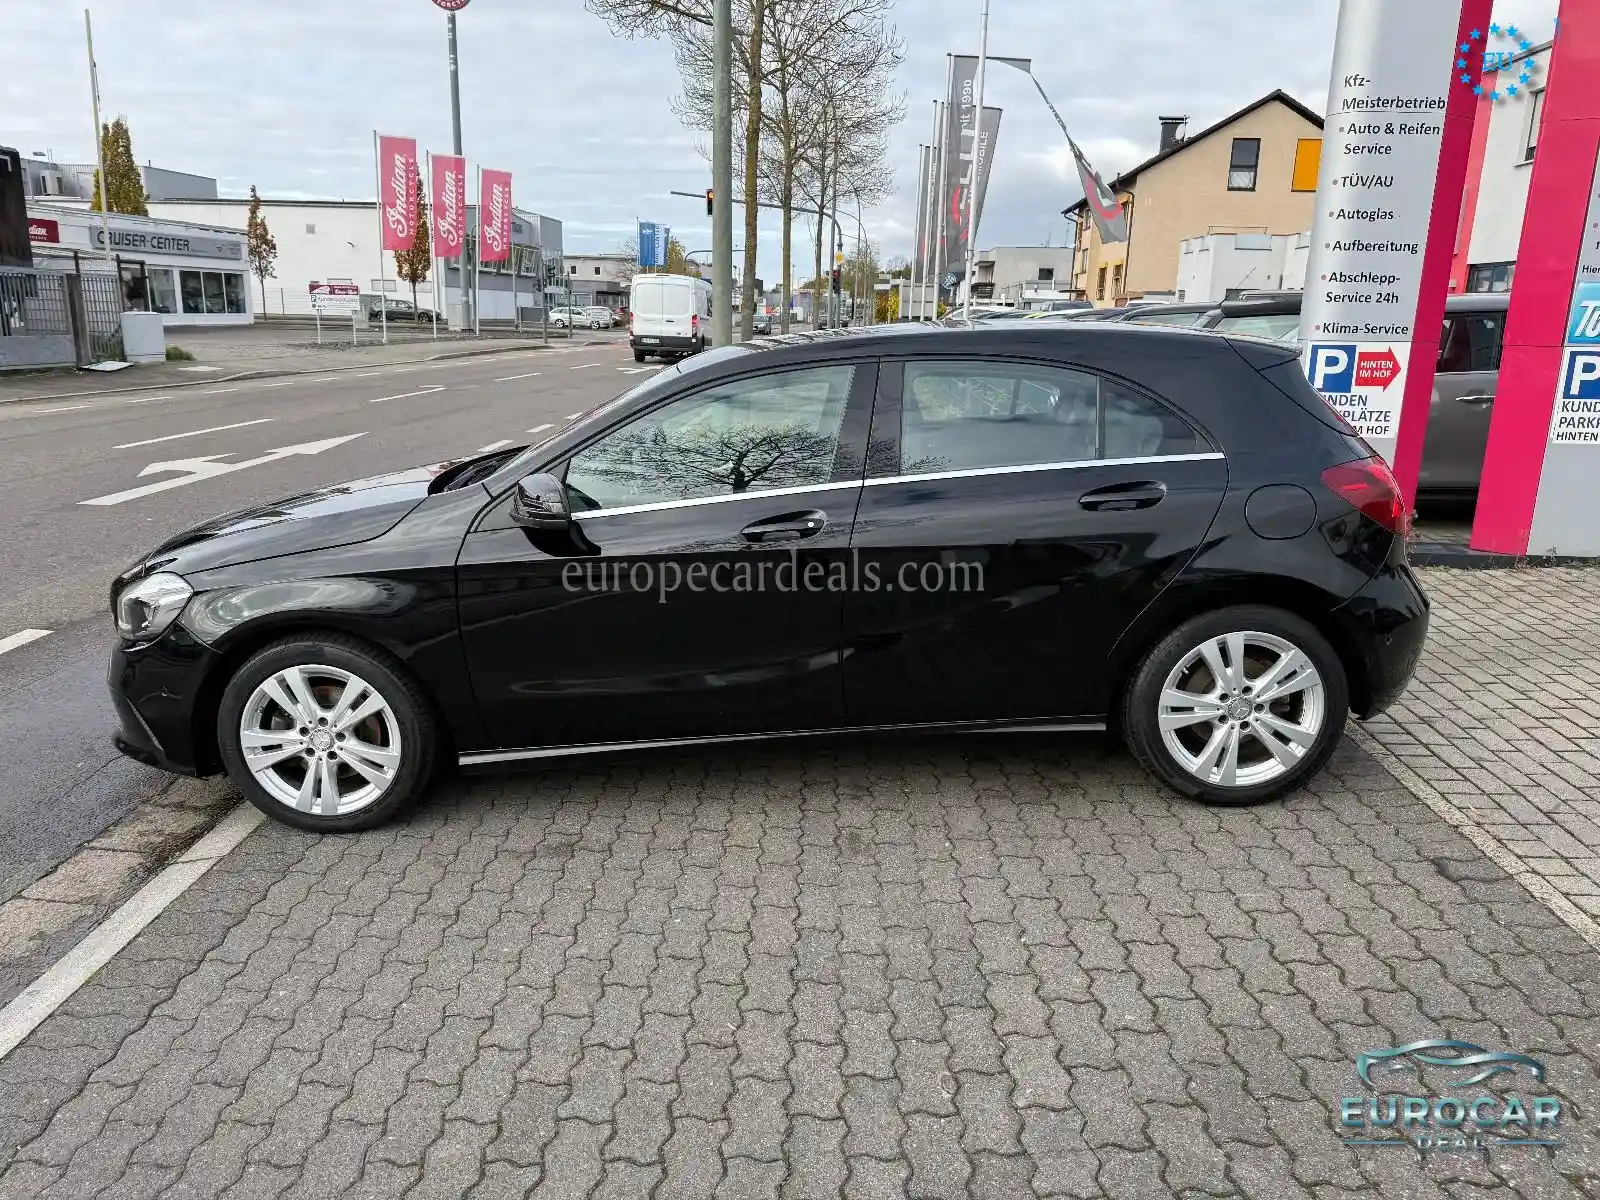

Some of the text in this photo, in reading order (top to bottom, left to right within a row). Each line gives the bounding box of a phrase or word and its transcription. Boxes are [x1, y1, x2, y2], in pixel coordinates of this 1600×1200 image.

[1344, 74, 1371, 88] Kfz-
[961, 79, 972, 109] 1990
[1342, 96, 1446, 110] Meisterbetrieb
[1347, 122, 1440, 135] Auto & Reifen
[1343, 143, 1392, 155] Service
[1341, 173, 1394, 189] TÜV/AU
[386, 153, 407, 237] Indian
[437, 170, 457, 246] Indian
[1336, 208, 1394, 222] Autoglas
[484, 183, 502, 251] Indian
[97, 230, 190, 252] CRUISER-CENTER
[1332, 240, 1419, 254] Aufbereitung
[1328, 272, 1401, 285] Abschlepp-
[1325, 292, 1399, 304] Service 24h
[1322, 323, 1409, 335] Klima-Service
[1313, 348, 1349, 389] P
[1360, 360, 1393, 369] HINTEN
[1359, 370, 1392, 378] IM HOF
[1323, 394, 1368, 406] NDEN
[1339, 408, 1391, 422] PLÄTZE
[1366, 425, 1390, 434] HOF
[1556, 431, 1599, 441] HINTEN
